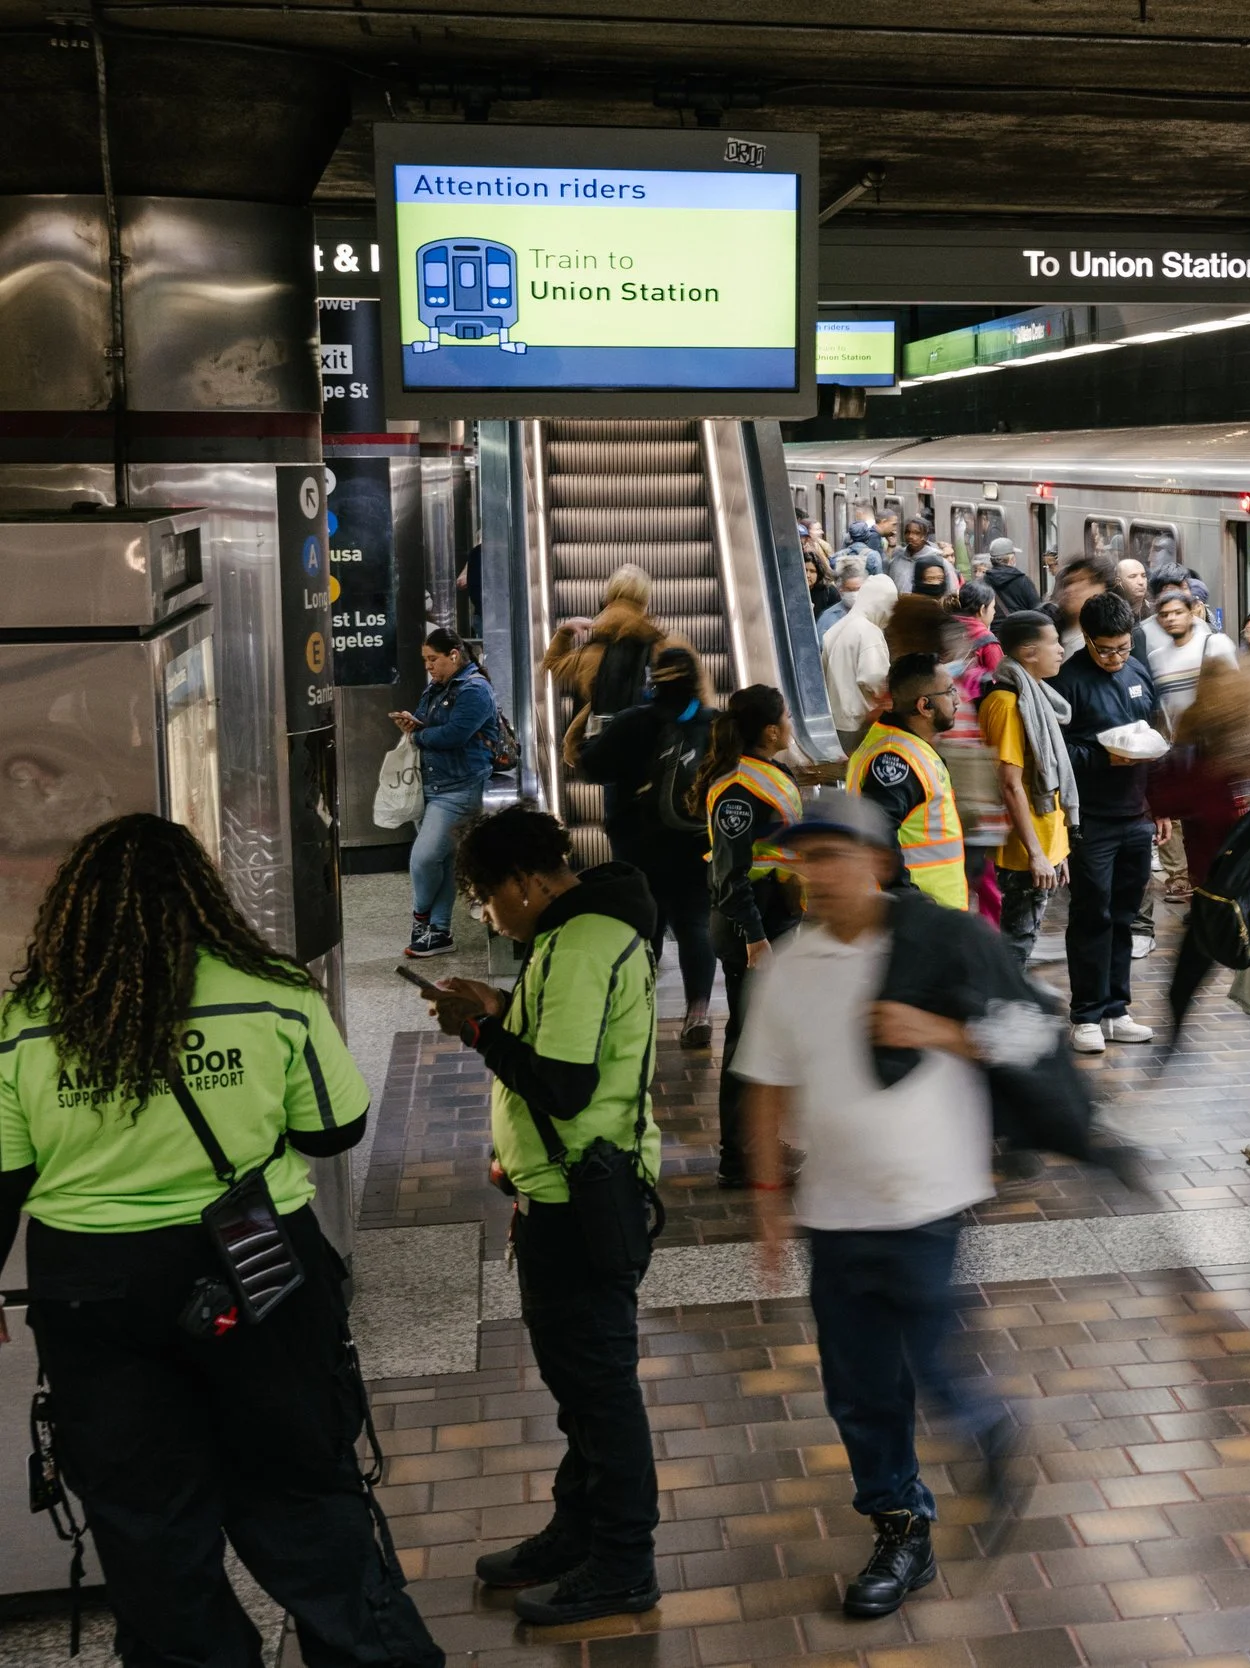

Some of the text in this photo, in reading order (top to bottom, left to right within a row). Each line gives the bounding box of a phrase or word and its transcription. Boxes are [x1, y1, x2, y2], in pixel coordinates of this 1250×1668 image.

[413, 174, 647, 200] Attention riders
[333, 243, 360, 273] &
[528, 249, 634, 270] Train to
[1023, 250, 1060, 276] To
[1070, 251, 1153, 277] Union
[530, 280, 720, 303] Union Station
[823, 323, 851, 331] riders
[321, 349, 348, 370] xit
[841, 353, 872, 361] Station
[323, 382, 369, 402] pe St
[308, 543, 318, 569] A
[330, 548, 363, 562] usa
[303, 588, 328, 612] Long
[332, 610, 386, 628] st Los
[311, 639, 321, 666] E
[58, 1090, 115, 1109] SUPPORT
[196, 1071, 245, 1091] REPORT
